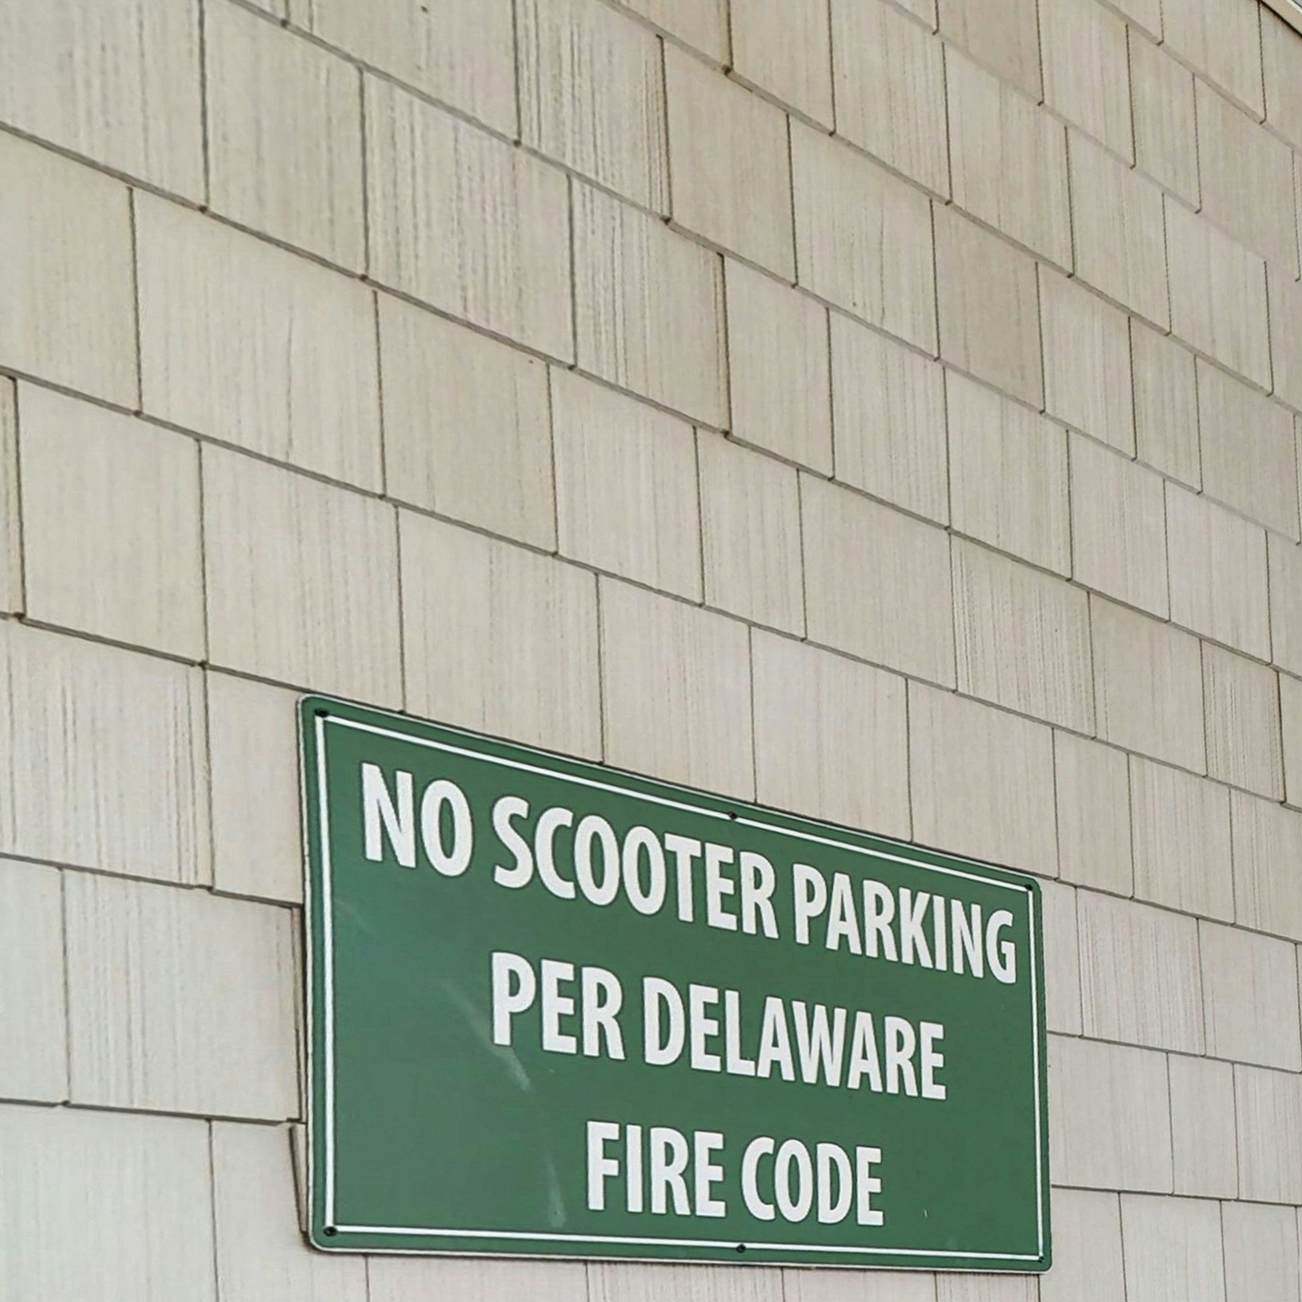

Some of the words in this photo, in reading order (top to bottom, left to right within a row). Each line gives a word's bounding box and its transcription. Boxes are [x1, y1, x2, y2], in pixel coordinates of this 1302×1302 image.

[362, 762, 474, 878] NO
[492, 796, 779, 939] SCOOTER
[792, 863, 1018, 984] PARKING
[491, 952, 626, 1060] PER
[643, 977, 947, 1100] DELAWARE
[586, 1120, 727, 1217] FIRE
[740, 1136, 884, 1226] CODE
